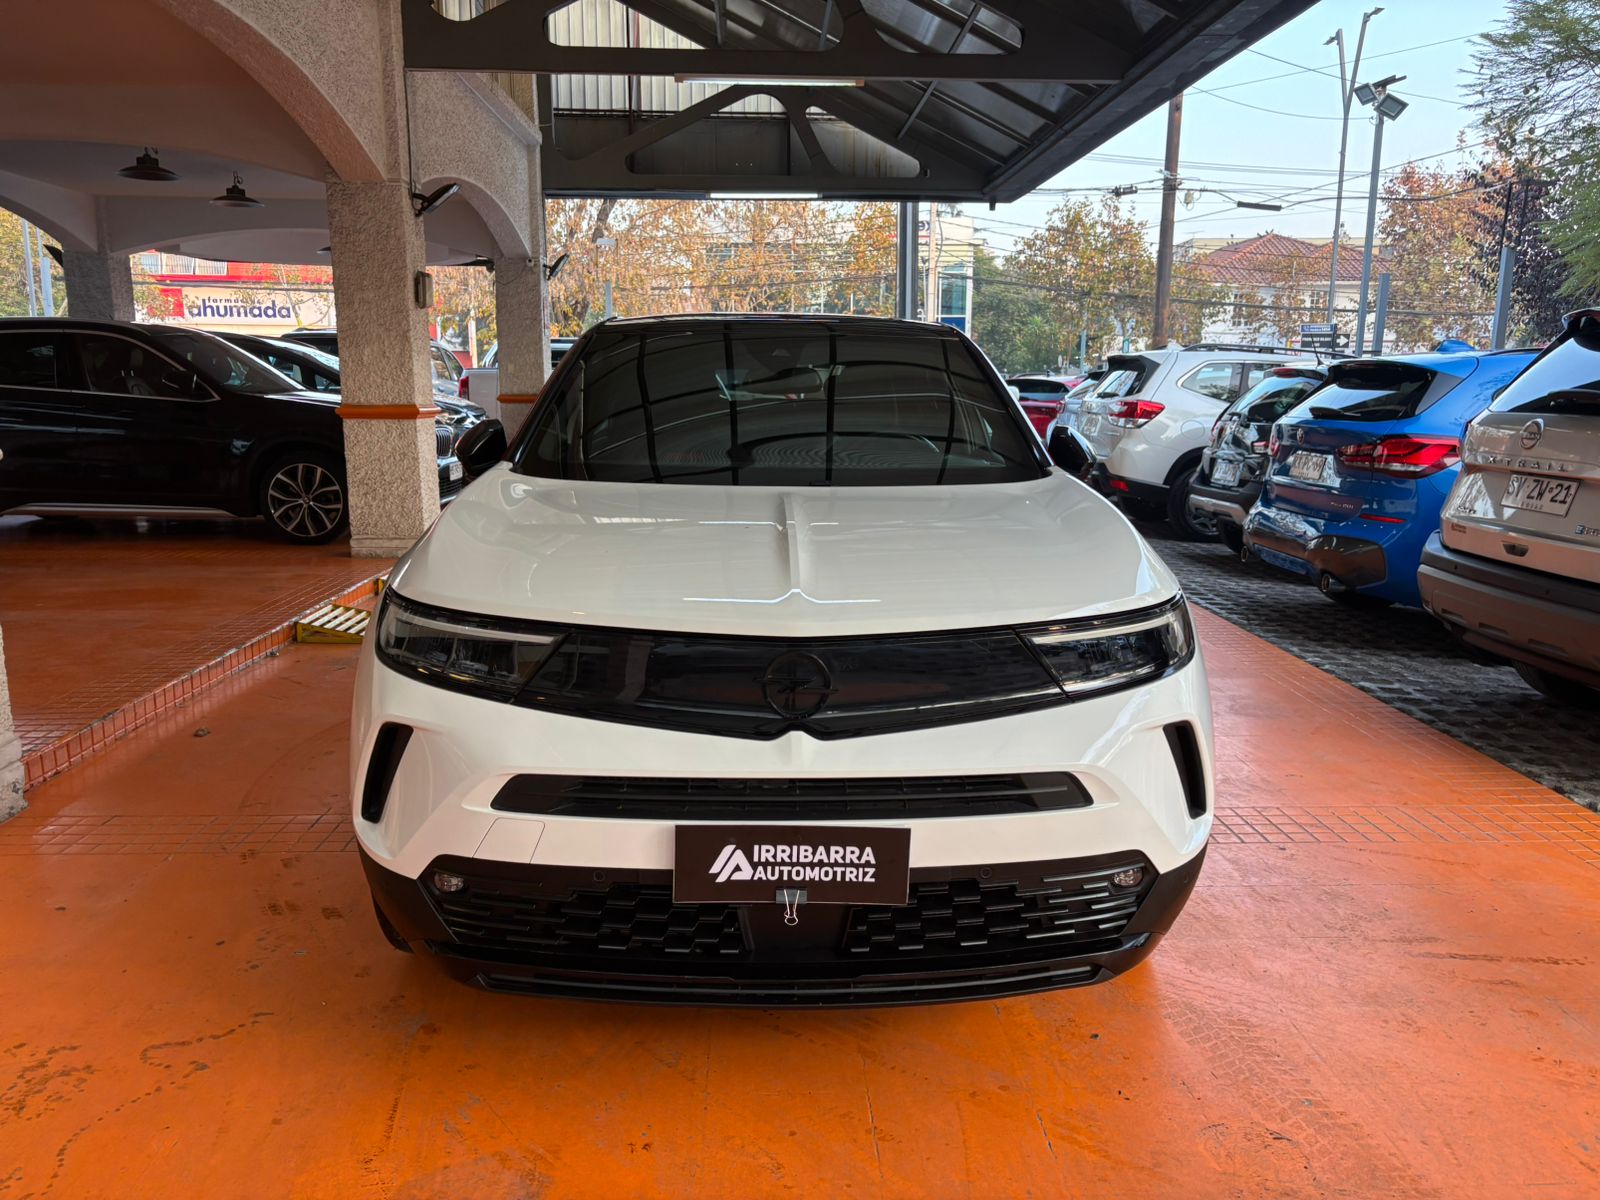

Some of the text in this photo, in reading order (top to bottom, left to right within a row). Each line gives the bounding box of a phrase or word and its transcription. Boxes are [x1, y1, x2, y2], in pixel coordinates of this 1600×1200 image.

[188, 299, 291, 319] ahumada
[753, 844, 876, 864] IRRIBARRA
[753, 866, 876, 882] AUTOMOTRIZ
